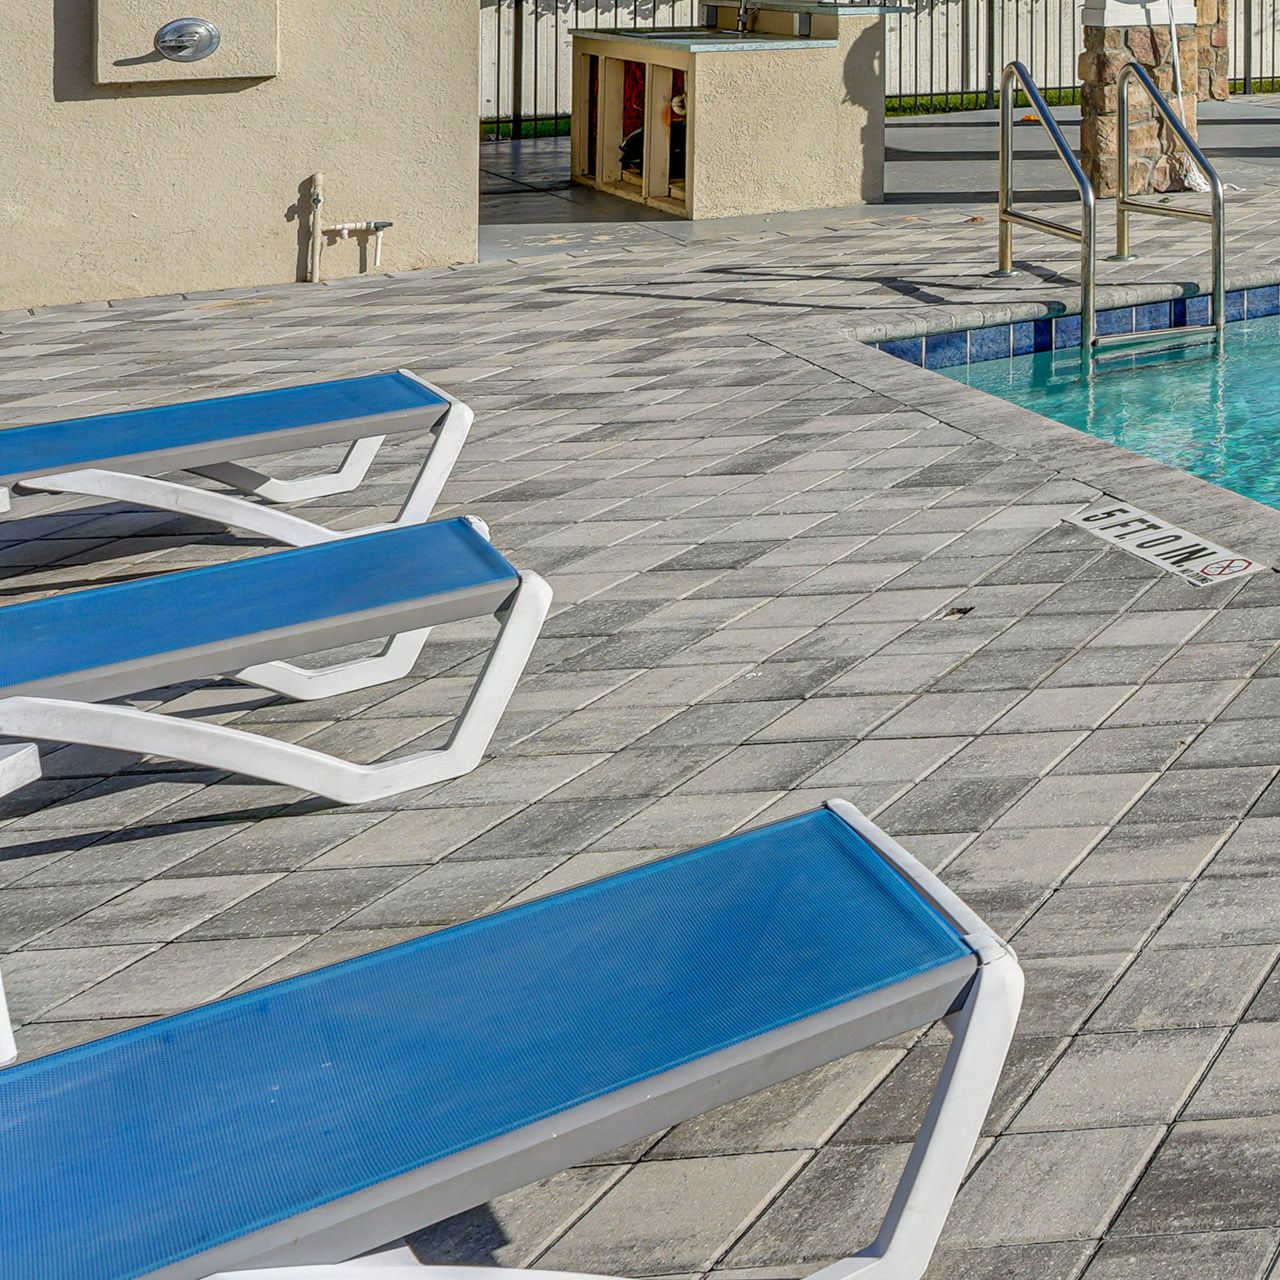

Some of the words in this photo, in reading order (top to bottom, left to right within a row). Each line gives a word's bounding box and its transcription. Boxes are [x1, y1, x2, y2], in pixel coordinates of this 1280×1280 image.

[1082, 508, 1131, 522] 5
[1100, 517, 1163, 540] FT.
[1136, 534, 1182, 549] 0
[1154, 543, 1217, 568] IN.
